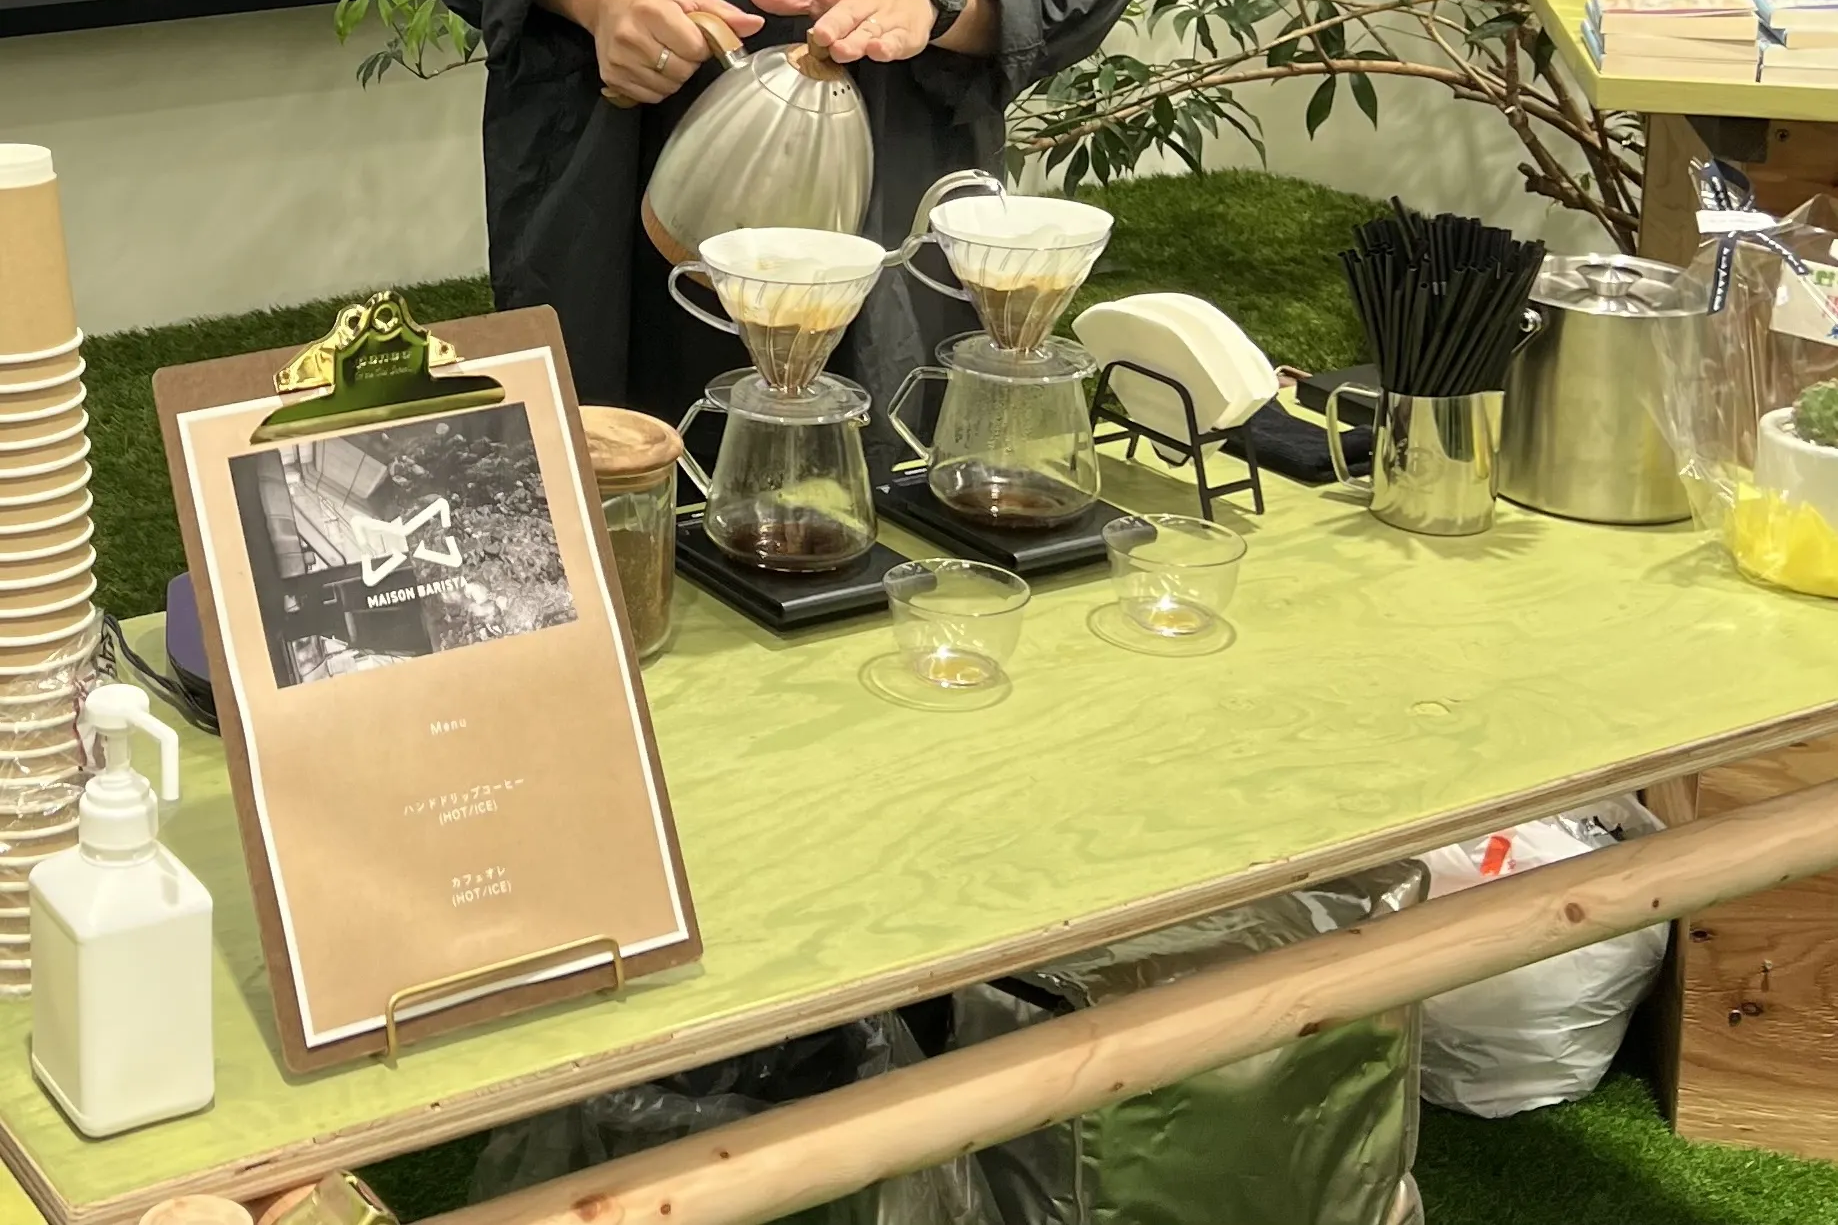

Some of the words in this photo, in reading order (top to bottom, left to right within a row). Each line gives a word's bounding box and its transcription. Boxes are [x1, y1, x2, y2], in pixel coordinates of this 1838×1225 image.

[367, 587, 416, 609] MAISON
[417, 576, 468, 597] BARISTA
[430, 718, 467, 735] Menu
[404, 778, 524, 816] ハンドドリップコーヒー
[439, 799, 498, 826] (HOT/ICE)
[451, 865, 506, 888] カフェオレ
[452, 880, 512, 907] (HOT/ICE)
